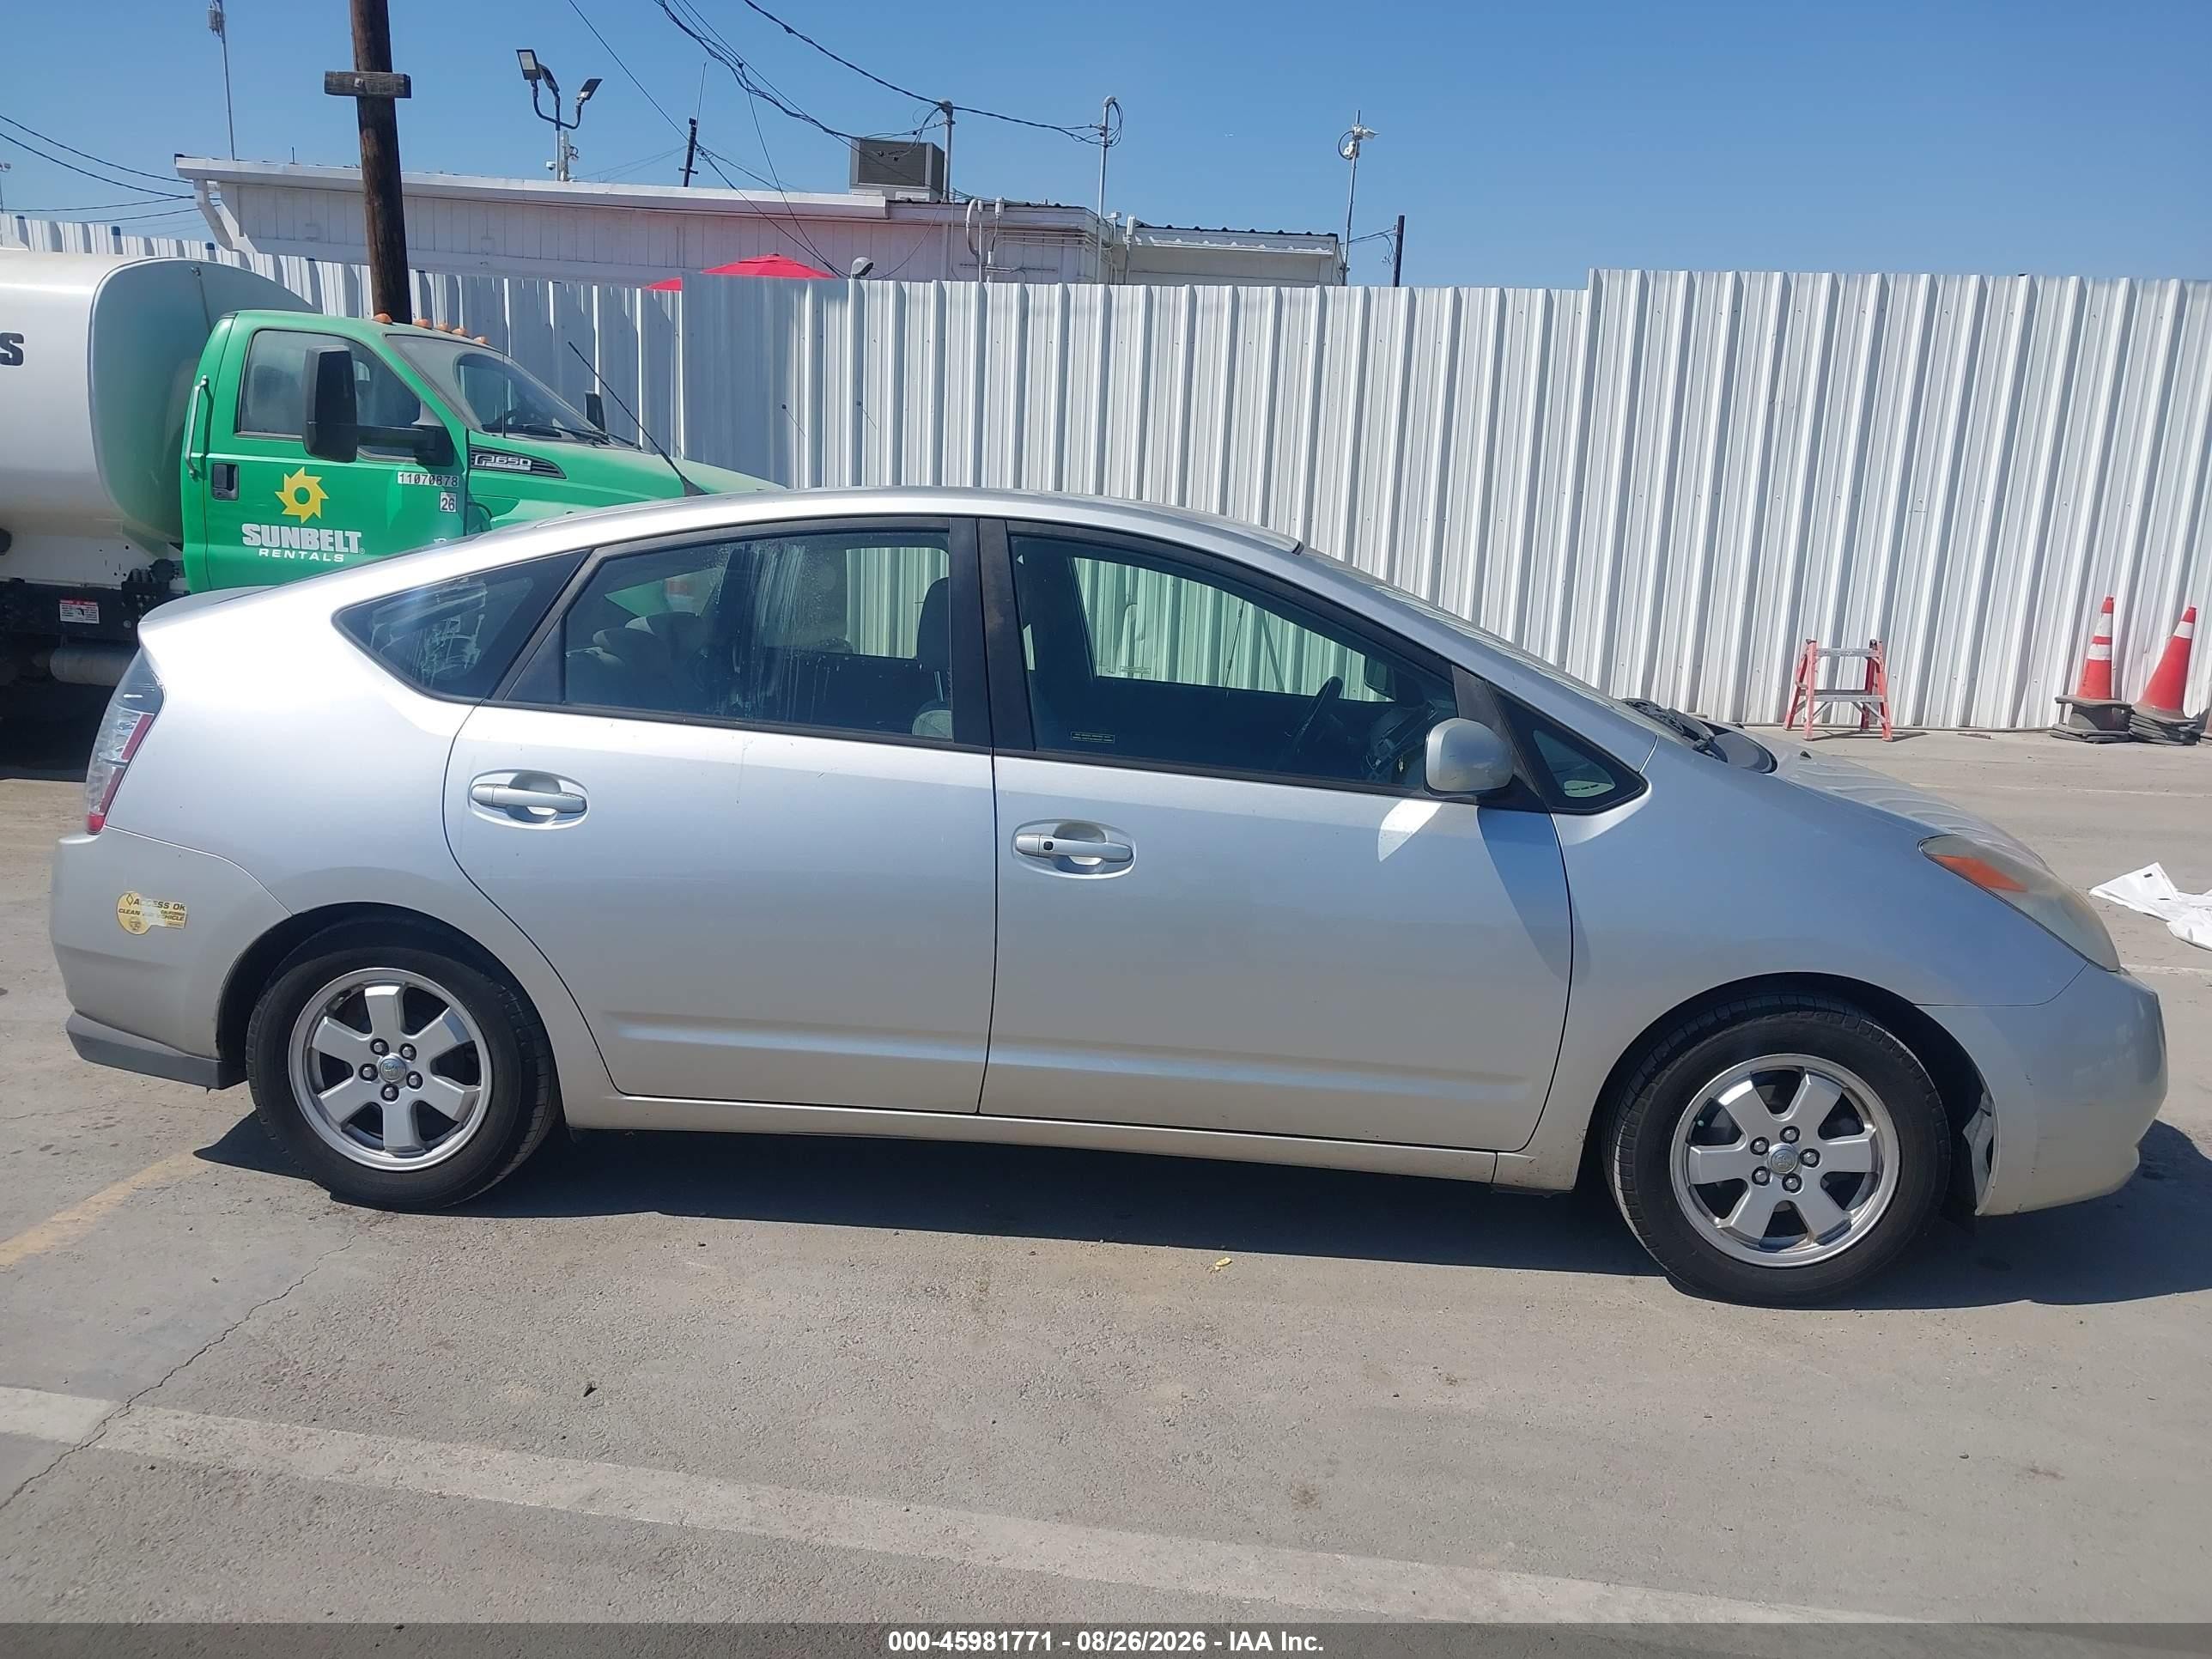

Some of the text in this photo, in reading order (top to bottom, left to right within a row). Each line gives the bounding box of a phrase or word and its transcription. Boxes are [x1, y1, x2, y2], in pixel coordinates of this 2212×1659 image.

[399, 473, 459, 487] 11070878
[441, 497, 455, 512] 26
[241, 523, 362, 554] SUNBELT
[258, 548, 344, 562] RENTALS
[132, 897, 186, 911] AESS OK
[118, 908, 141, 916] CLEAN
